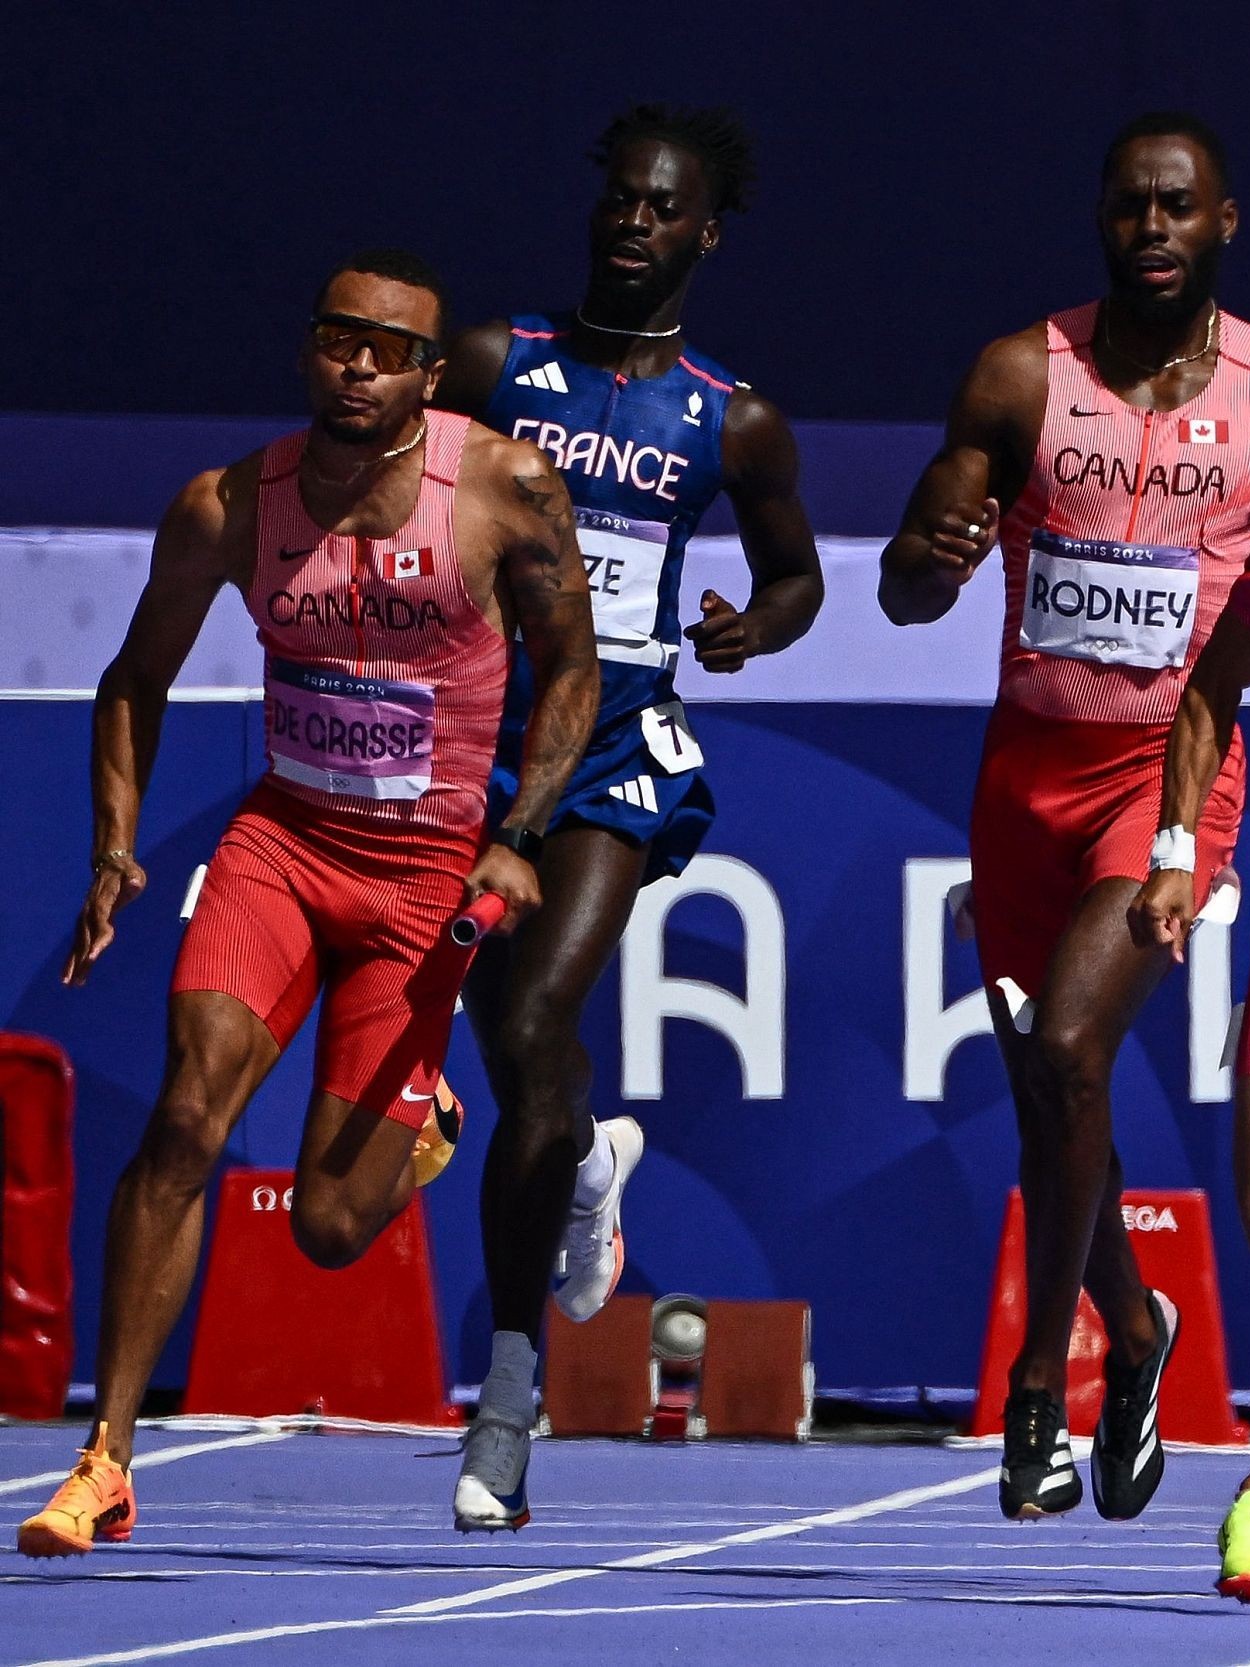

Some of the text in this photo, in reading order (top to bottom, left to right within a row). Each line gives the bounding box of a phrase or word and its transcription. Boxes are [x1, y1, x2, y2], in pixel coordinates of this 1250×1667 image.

[1053, 446, 1225, 503] CANADA
[1064, 541, 1154, 561] PARIS 2024
[582, 554, 626, 596] ZE
[267, 589, 447, 631] CANADA
[1031, 571, 1193, 629] RODNEY
[303, 673, 385, 697] PARIS 2024
[273, 700, 427, 759] DE GRASSE
[656, 715, 684, 757] 7
[1121, 1205, 1178, 1232] EGA
